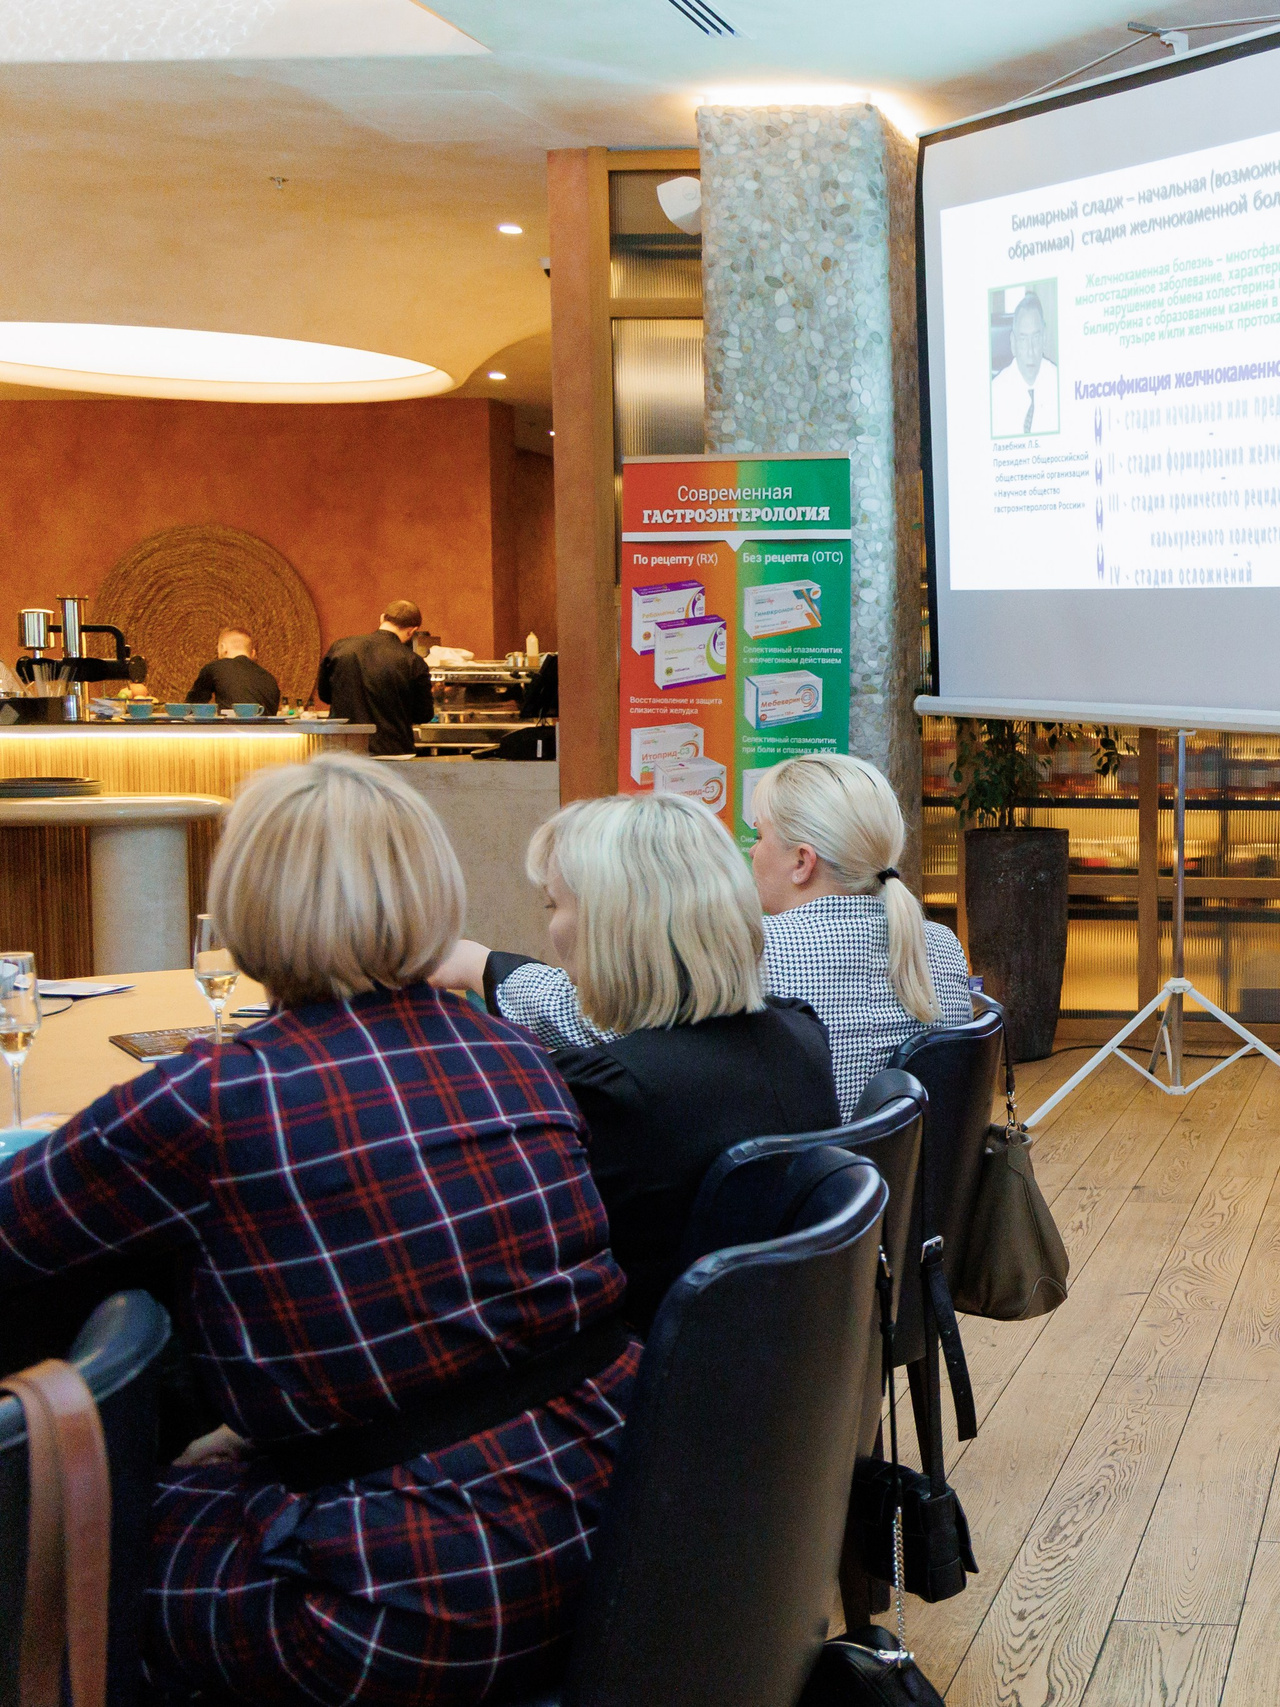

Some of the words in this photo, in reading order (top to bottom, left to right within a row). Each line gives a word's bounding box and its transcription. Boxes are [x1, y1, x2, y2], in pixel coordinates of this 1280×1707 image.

[1011, 200, 1079, 232] Билиарный
[1082, 190, 1123, 217] сладж
[1138, 175, 1206, 204] начальная
[1008, 229, 1075, 261] обратимая)
[1082, 223, 1126, 249] стадия
[1129, 193, 1248, 236] желчнокаменной
[1085, 262, 1170, 289] Желчнокаменная
[1172, 255, 1214, 275] болезнь
[1074, 282, 1156, 306] многостадийное
[1158, 267, 1225, 290] заболевание,
[1103, 296, 1165, 318] нарушением
[1167, 289, 1204, 308] обмена
[1206, 278, 1276, 300] холестерина
[1083, 312, 1144, 337] билирубина
[1145, 316, 1152, 327] с
[1154, 303, 1225, 328] образованием
[1228, 295, 1269, 315] камней
[1271, 295, 1279, 306] в
[1119, 329, 1156, 348] пузыре
[1158, 325, 1185, 341] и/или
[1187, 319, 1235, 337] желчных
[1074, 369, 1171, 402] Классификация
[1124, 406, 1161, 430] стадия
[1166, 402, 1222, 426] начальная
[1227, 398, 1248, 420] или
[993, 442, 1026, 452] Лазебник
[993, 455, 1030, 468] Президент
[1032, 451, 1090, 466] Общероссийской
[1127, 450, 1162, 477] стадия
[1167, 442, 1244, 479] формирования
[995, 471, 1045, 483] общественной
[1046, 469, 1090, 481] организации
[677, 484, 792, 505] Современная
[1029, 486, 1060, 496] общество
[993, 500, 1056, 514] гастроэнтерологов
[1131, 492, 1165, 515] стадия
[1169, 486, 1240, 515] хронического
[642, 506, 830, 524] ГАСТРОЭНТЕРОЛОГИЯ
[633, 554, 650, 565] По
[651, 554, 694, 567] рецепту
[696, 552, 719, 567] (RX)
[742, 551, 763, 563] Без
[765, 552, 809, 565] рецепта
[1134, 564, 1173, 588] стадия
[1178, 560, 1253, 586] осложнений
[743, 645, 792, 654] Селективный
[793, 647, 843, 655] спазмолитик
[799, 655, 842, 665] действием
[629, 696, 688, 705] Восстановление
[696, 698, 722, 706] защита
[629, 706, 668, 714] слизистой
[741, 735, 790, 744] Селективный
[756, 745, 775, 753] боли
[820, 746, 838, 754] ЖКТ
